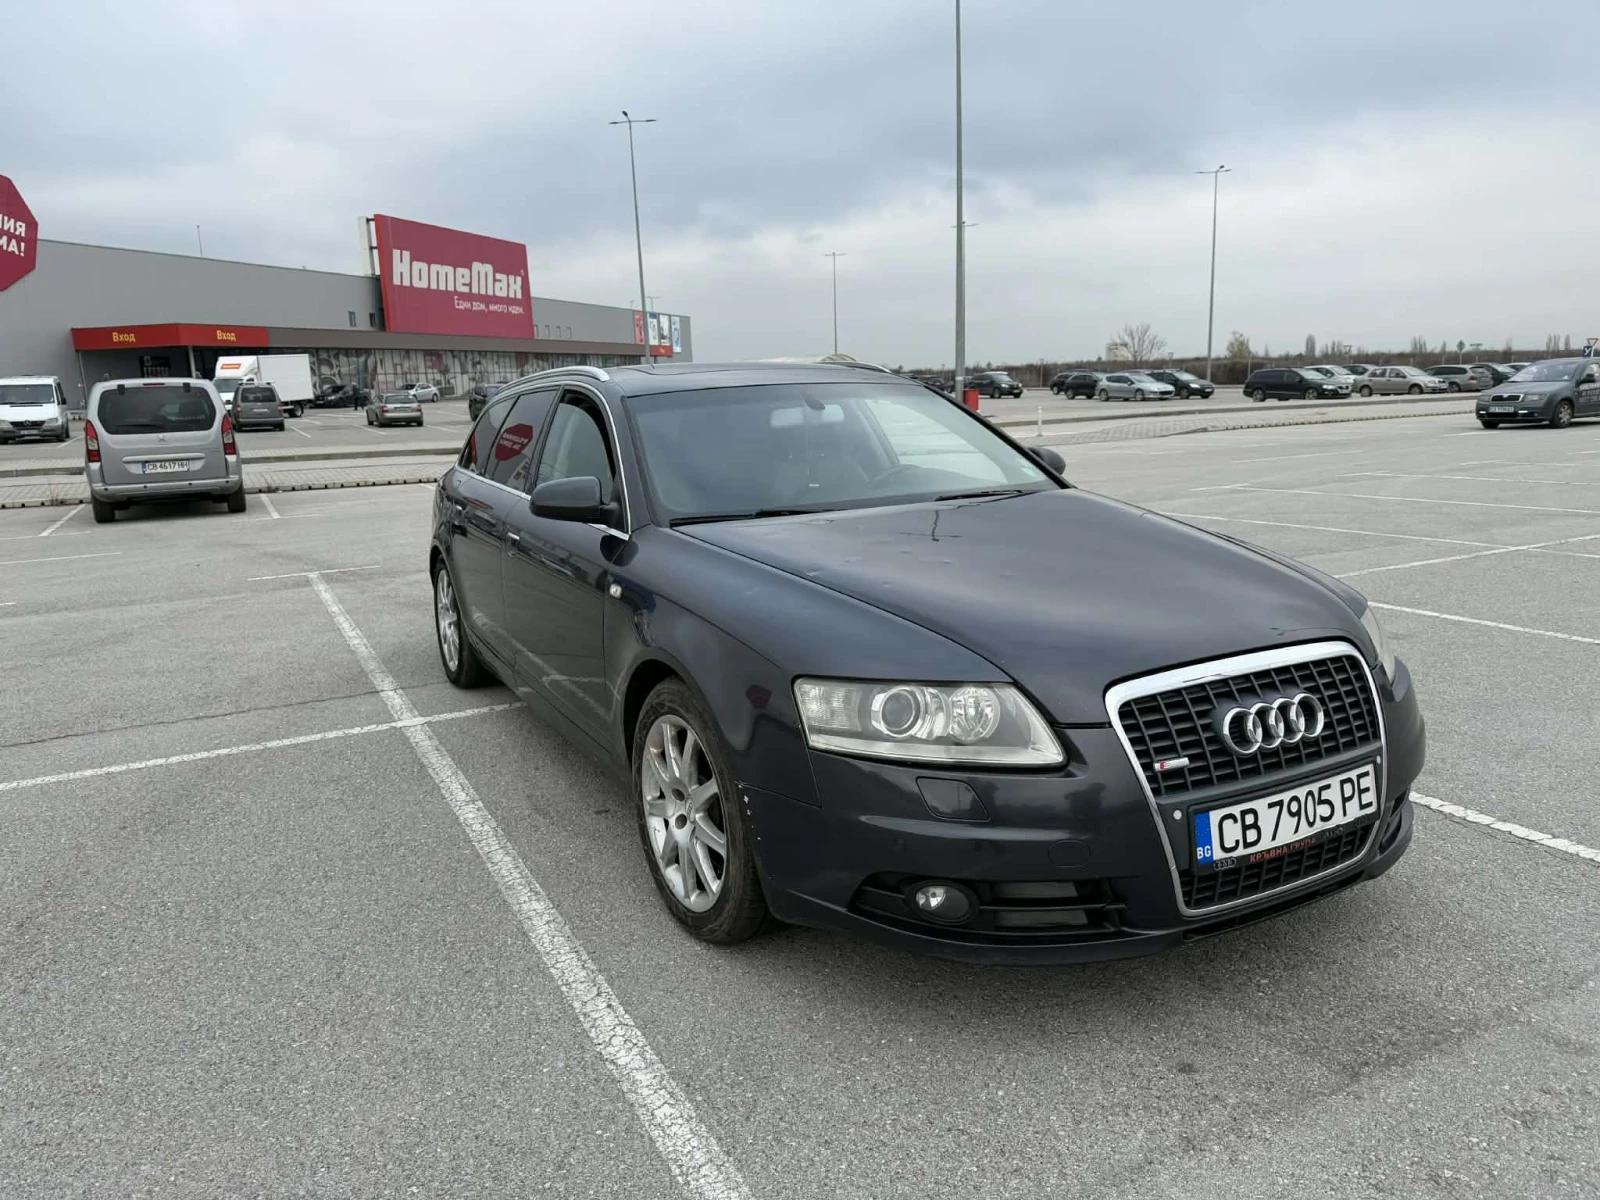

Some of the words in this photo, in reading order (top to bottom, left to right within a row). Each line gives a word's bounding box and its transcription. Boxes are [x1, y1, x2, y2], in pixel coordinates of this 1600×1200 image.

[392, 248, 523, 300] HomeMax
[454, 296, 472, 309] Един
[112, 332, 136, 343] Вход
[216, 330, 236, 341] Вход
[1267, 783, 1335, 842] 7905
[1196, 845, 1212, 860] BG
